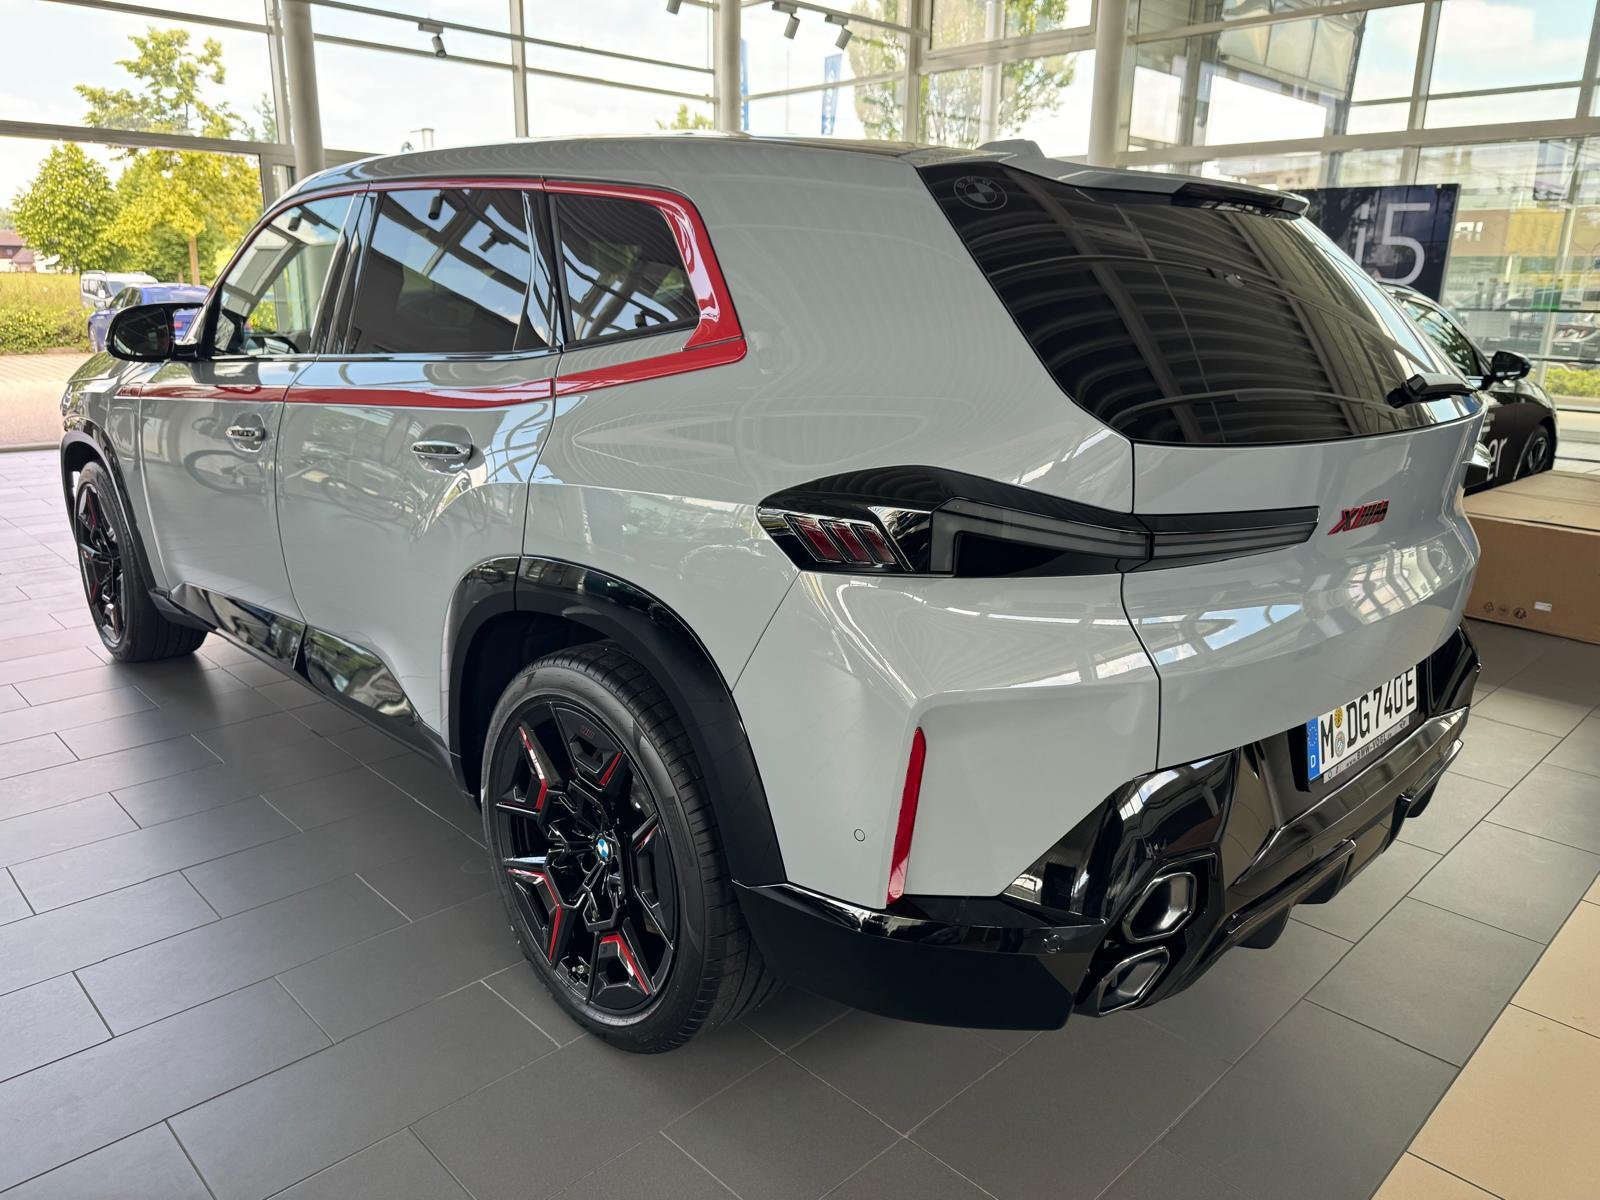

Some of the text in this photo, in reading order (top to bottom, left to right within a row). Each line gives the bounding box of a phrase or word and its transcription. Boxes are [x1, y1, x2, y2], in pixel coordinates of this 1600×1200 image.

[1354, 202, 1430, 285] i5
[1310, 755, 1316, 768] D
[1320, 714, 1334, 764] M
[1346, 694, 1369, 748] DG
